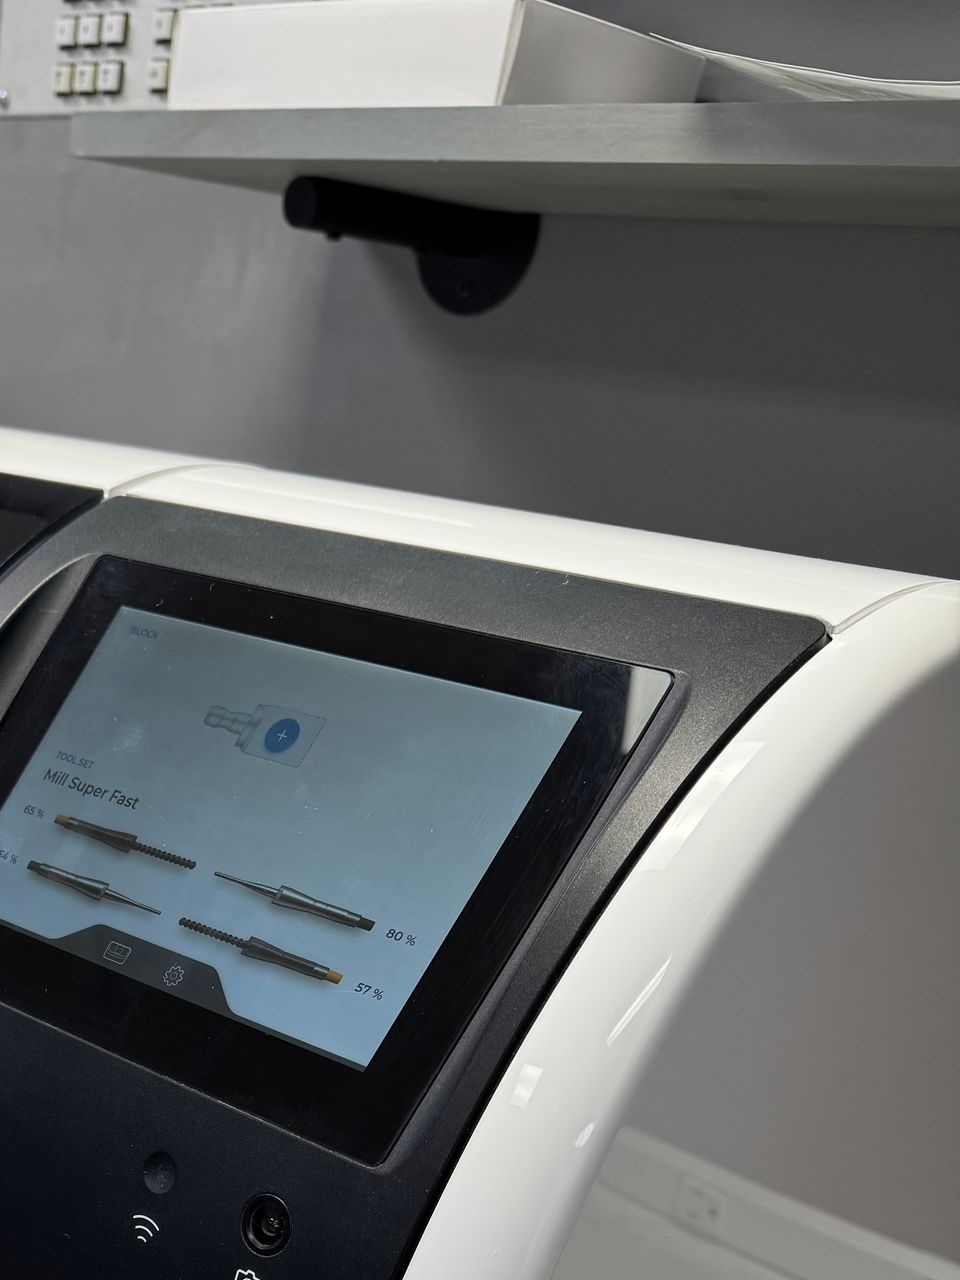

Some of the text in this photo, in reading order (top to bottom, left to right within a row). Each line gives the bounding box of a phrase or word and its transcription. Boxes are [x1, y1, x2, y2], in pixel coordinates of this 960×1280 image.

[43, 768, 140, 810] Mill Super Fast
[24, 805, 37, 815] 65
[386, 929, 417, 946] 80 %
[354, 982, 384, 1001] 57 %
